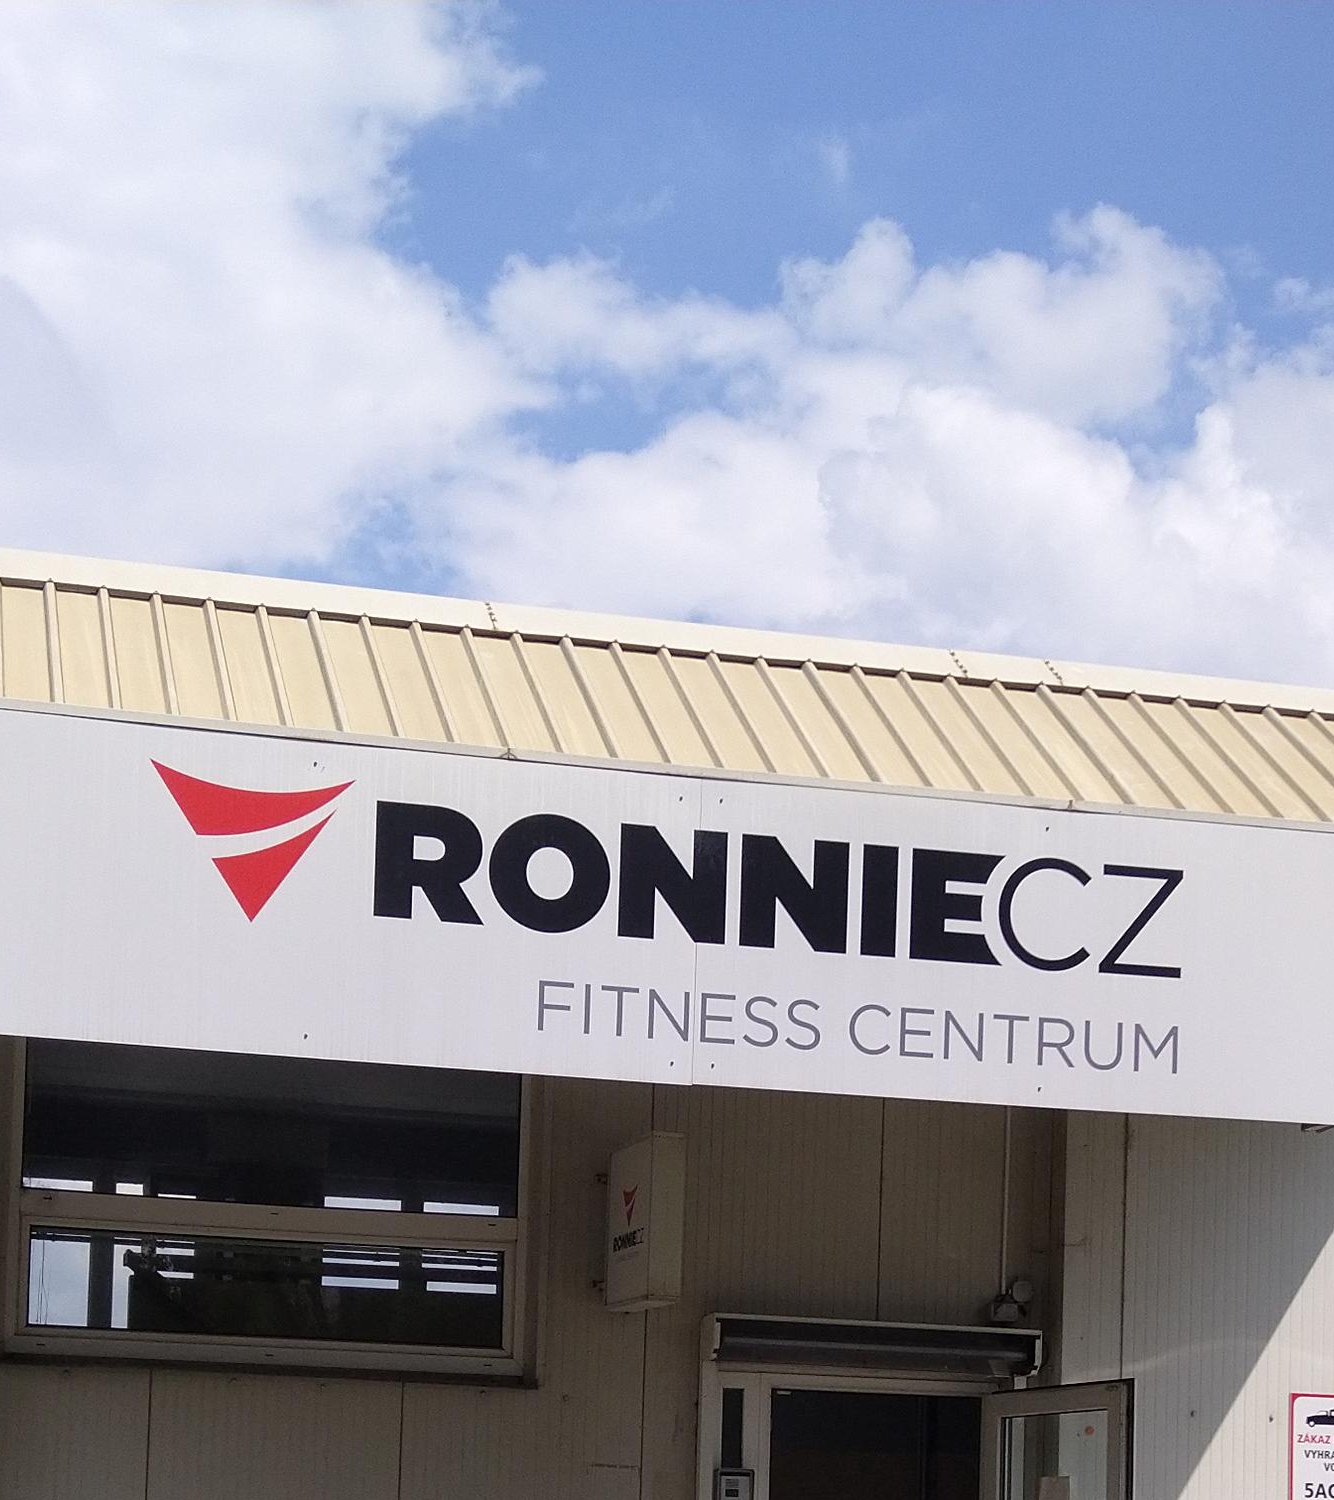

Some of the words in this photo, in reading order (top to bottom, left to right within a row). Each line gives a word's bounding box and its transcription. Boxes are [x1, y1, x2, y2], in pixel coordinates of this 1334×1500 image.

[373, 798, 1185, 979] RONNIECZ
[536, 980, 823, 1051] FITNESS
[848, 1003, 1181, 1075] CENTRUM
[1297, 1433, 1330, 1444] ZÁKAZ
